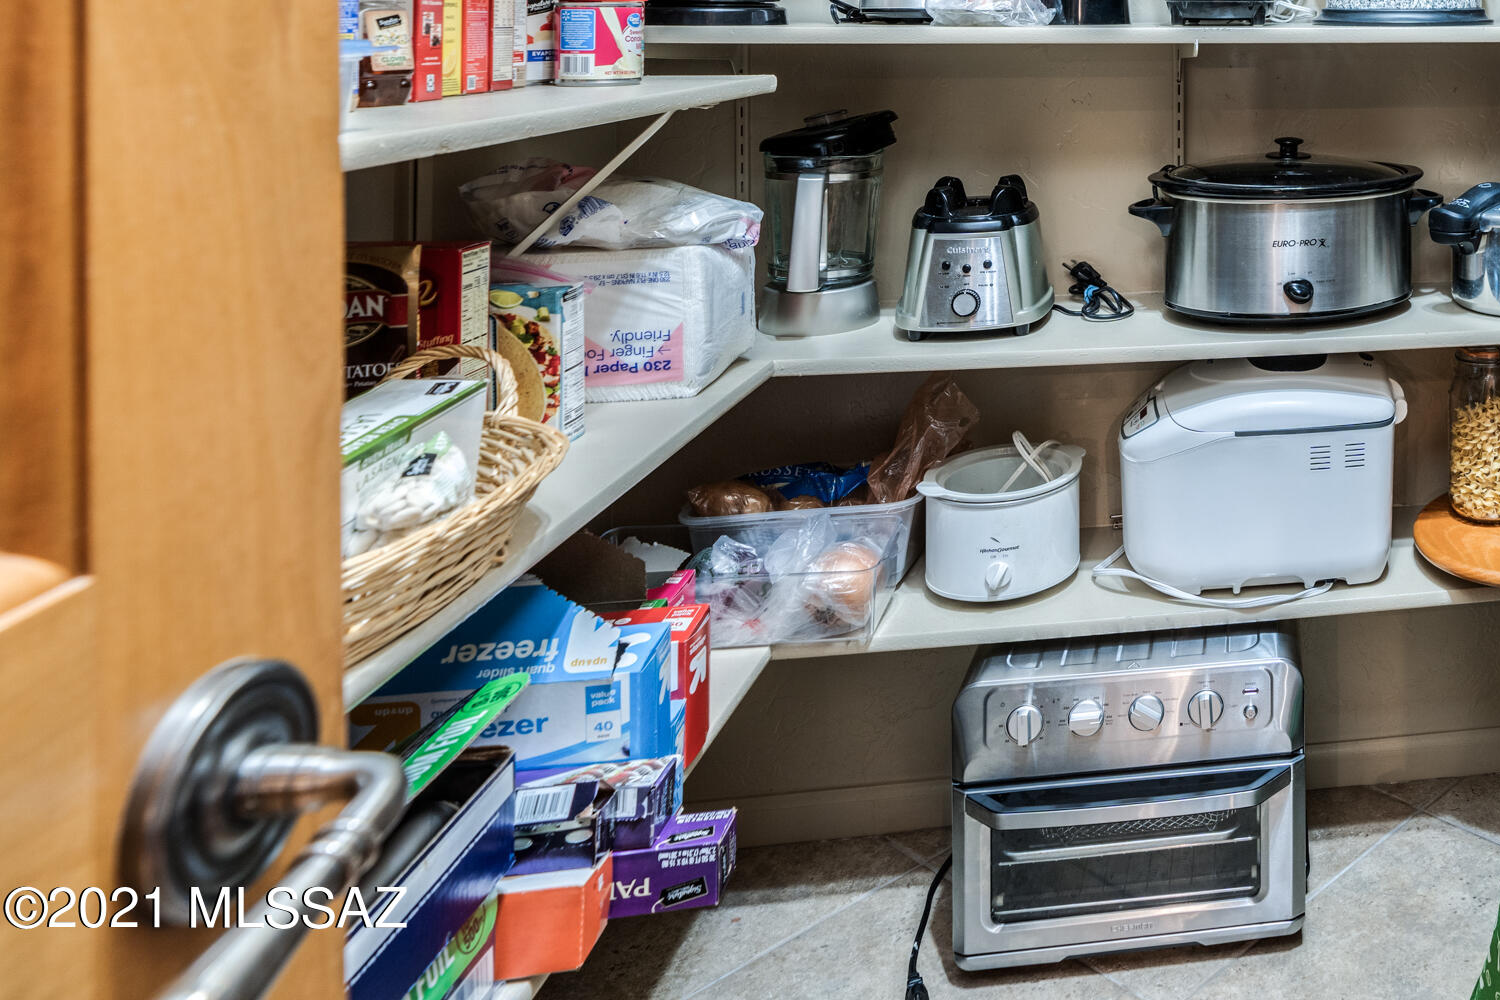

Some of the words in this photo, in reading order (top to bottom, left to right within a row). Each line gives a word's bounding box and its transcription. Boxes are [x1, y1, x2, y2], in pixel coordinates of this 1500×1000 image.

[1272, 238, 1318, 248] EURO-PRO
[609, 329, 672, 342] Friendly.
[611, 345, 655, 358] Finger
[592, 360, 639, 375] Paper
[650, 359, 672, 371] 230
[441, 636, 560, 665] freezer
[475, 665, 515, 680] slider
[590, 688, 617, 700] value
[591, 697, 616, 708] pack
[424, 709, 489, 754] FOIL
[480, 715, 549, 740] ezer
[593, 720, 614, 732] 40
